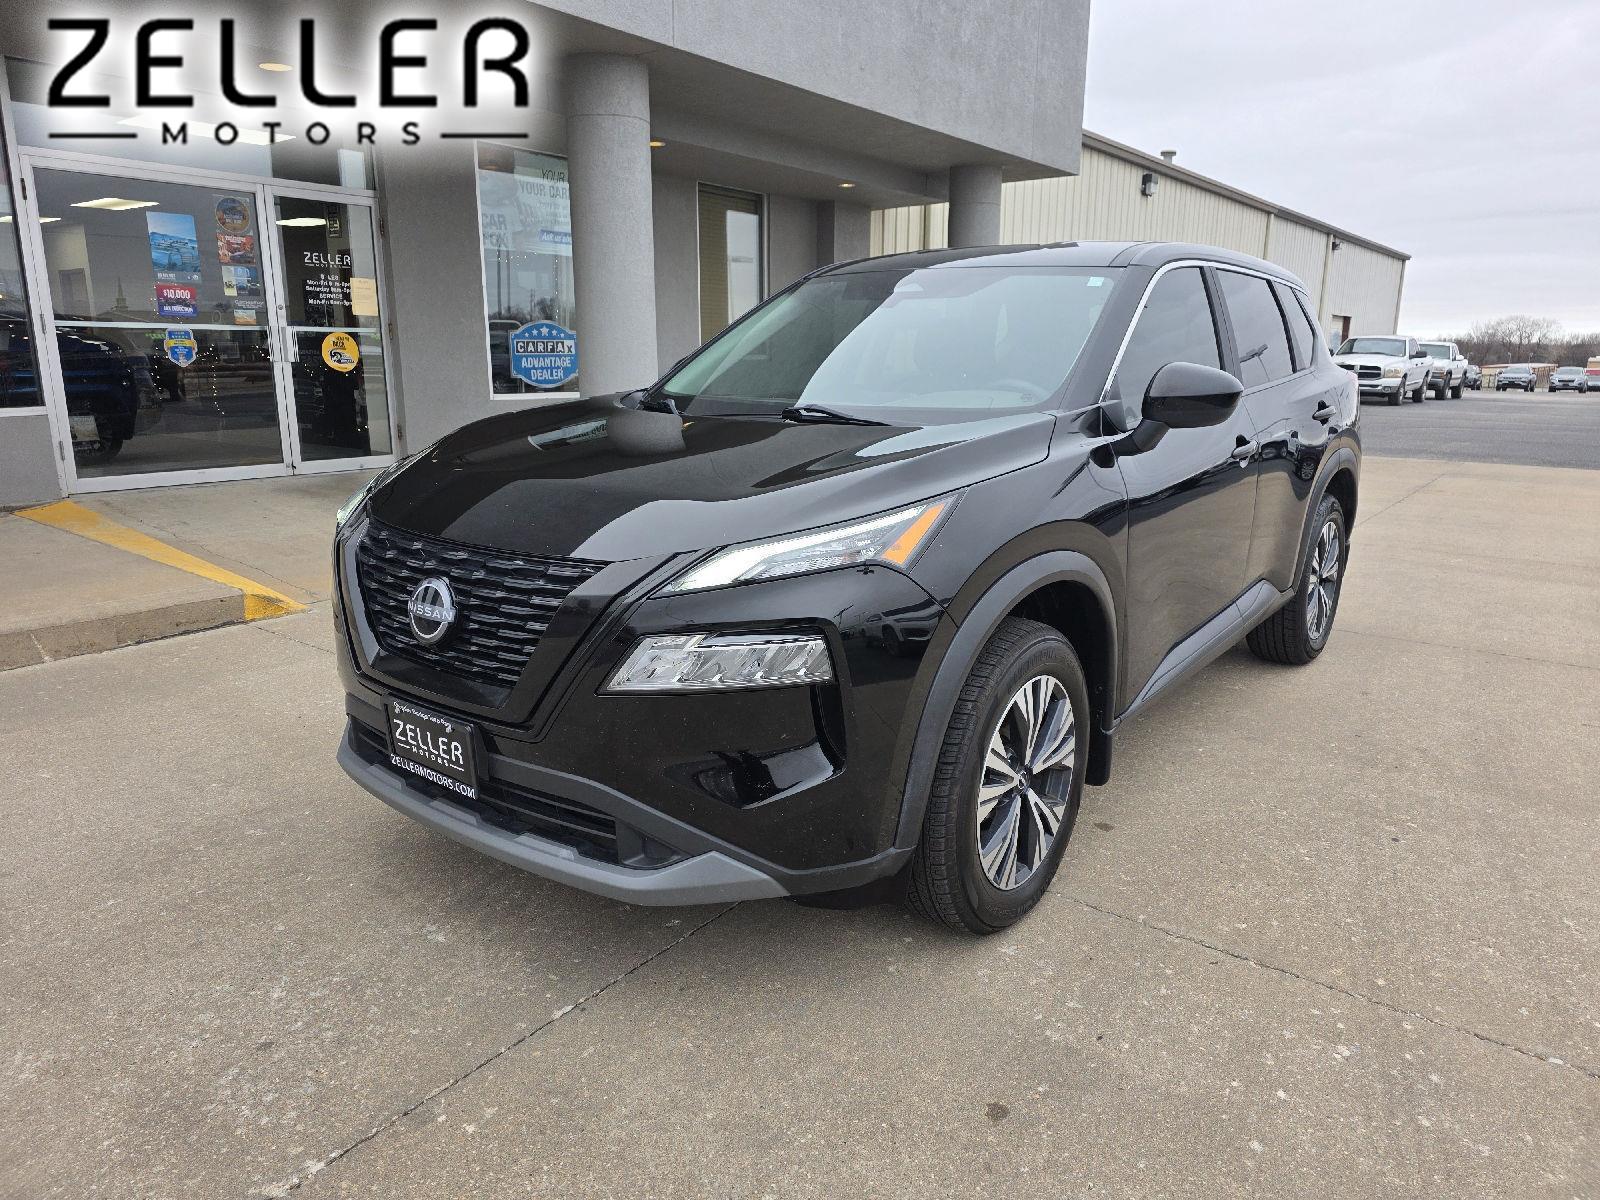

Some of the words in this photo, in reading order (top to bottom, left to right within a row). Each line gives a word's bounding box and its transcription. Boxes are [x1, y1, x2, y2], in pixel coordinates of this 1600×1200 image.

[519, 181, 546, 197] YOUR
[304, 252, 350, 265] ZELLER
[516, 341, 574, 353] CARFAX
[521, 356, 572, 368] ADVANTAGE
[530, 369, 564, 380] DEALER
[408, 601, 453, 621] NISSAN
[394, 719, 464, 765] ZELLER
[412, 746, 449, 767] MOTORS
[390, 754, 477, 800] ZELLERMOTORS.COM
